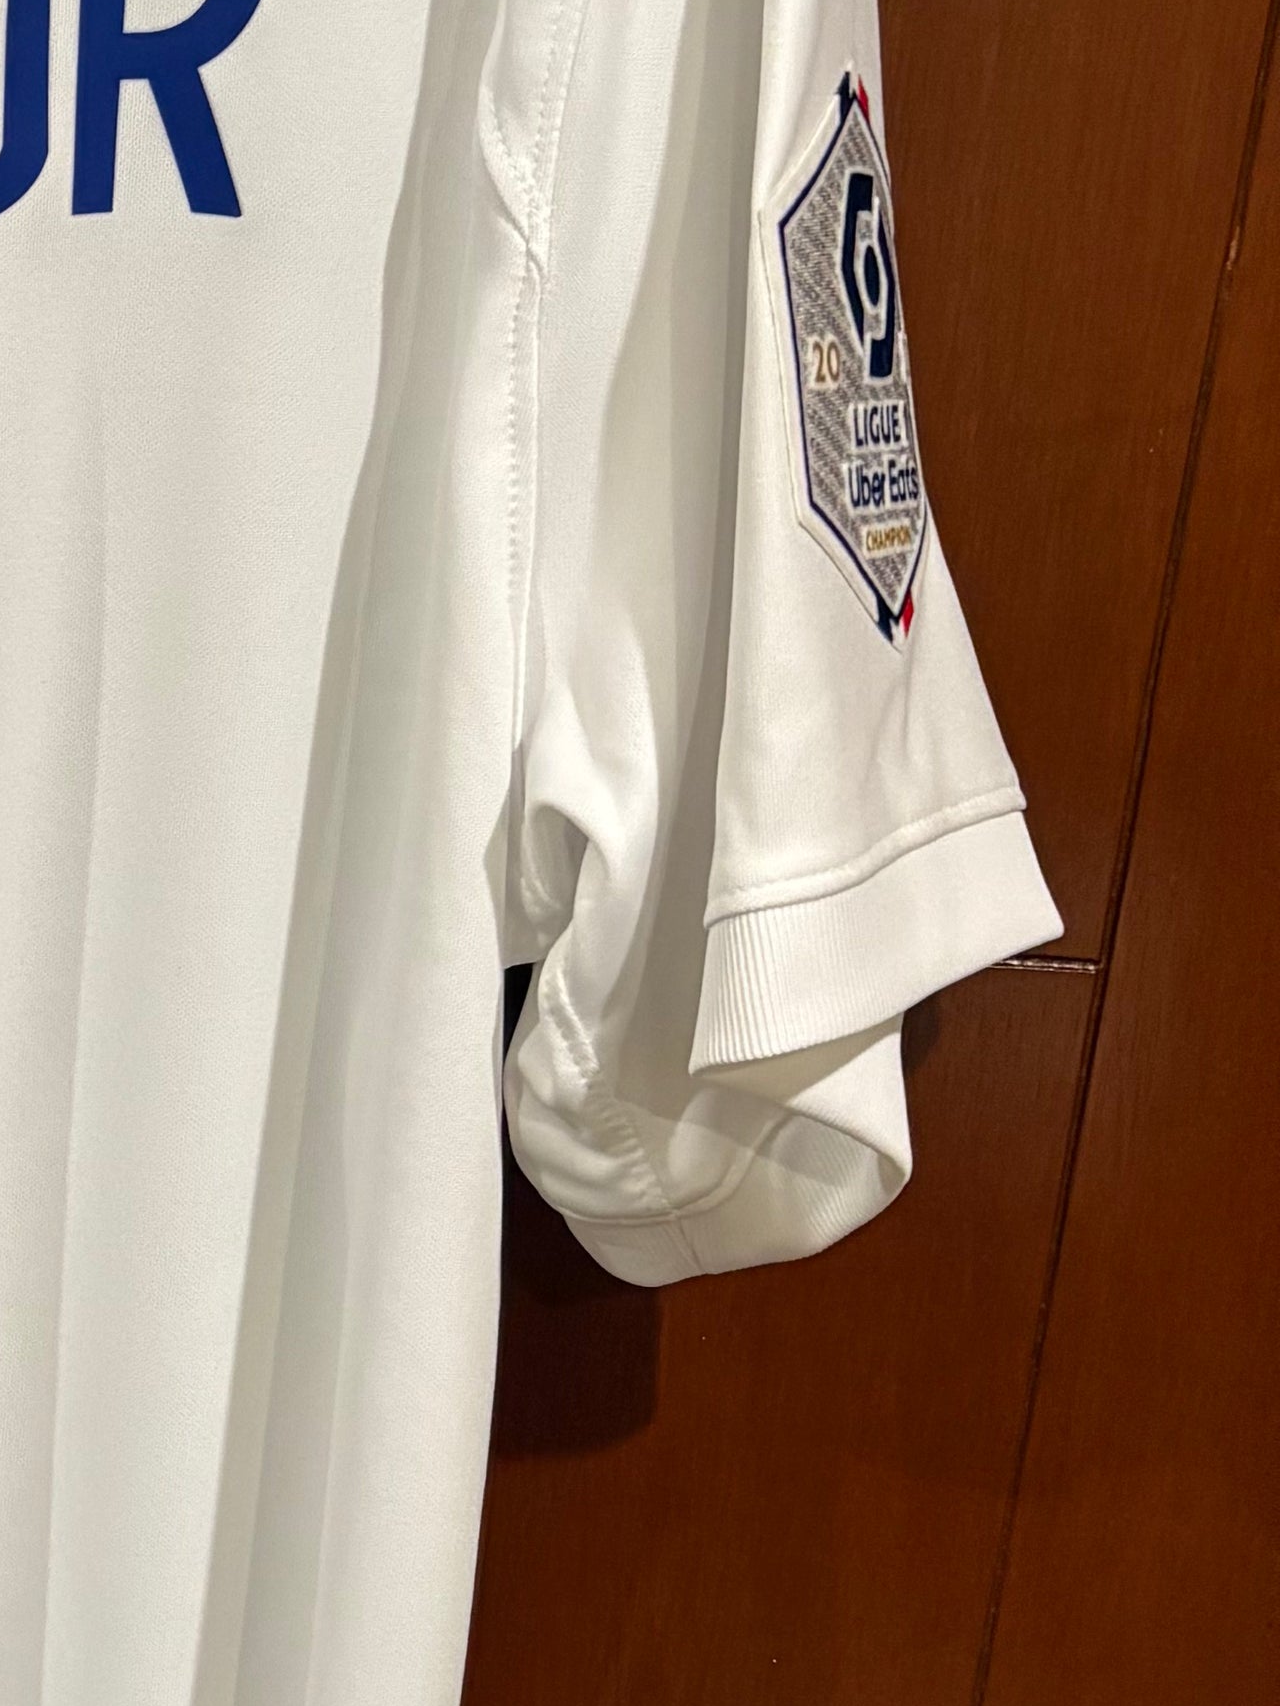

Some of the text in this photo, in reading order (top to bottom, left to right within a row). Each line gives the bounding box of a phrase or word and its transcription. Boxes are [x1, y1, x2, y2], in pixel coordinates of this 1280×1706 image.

[813, 341, 840, 383] 20
[853, 405, 901, 447] LIGUE
[848, 459, 919, 508] Uber Eats
